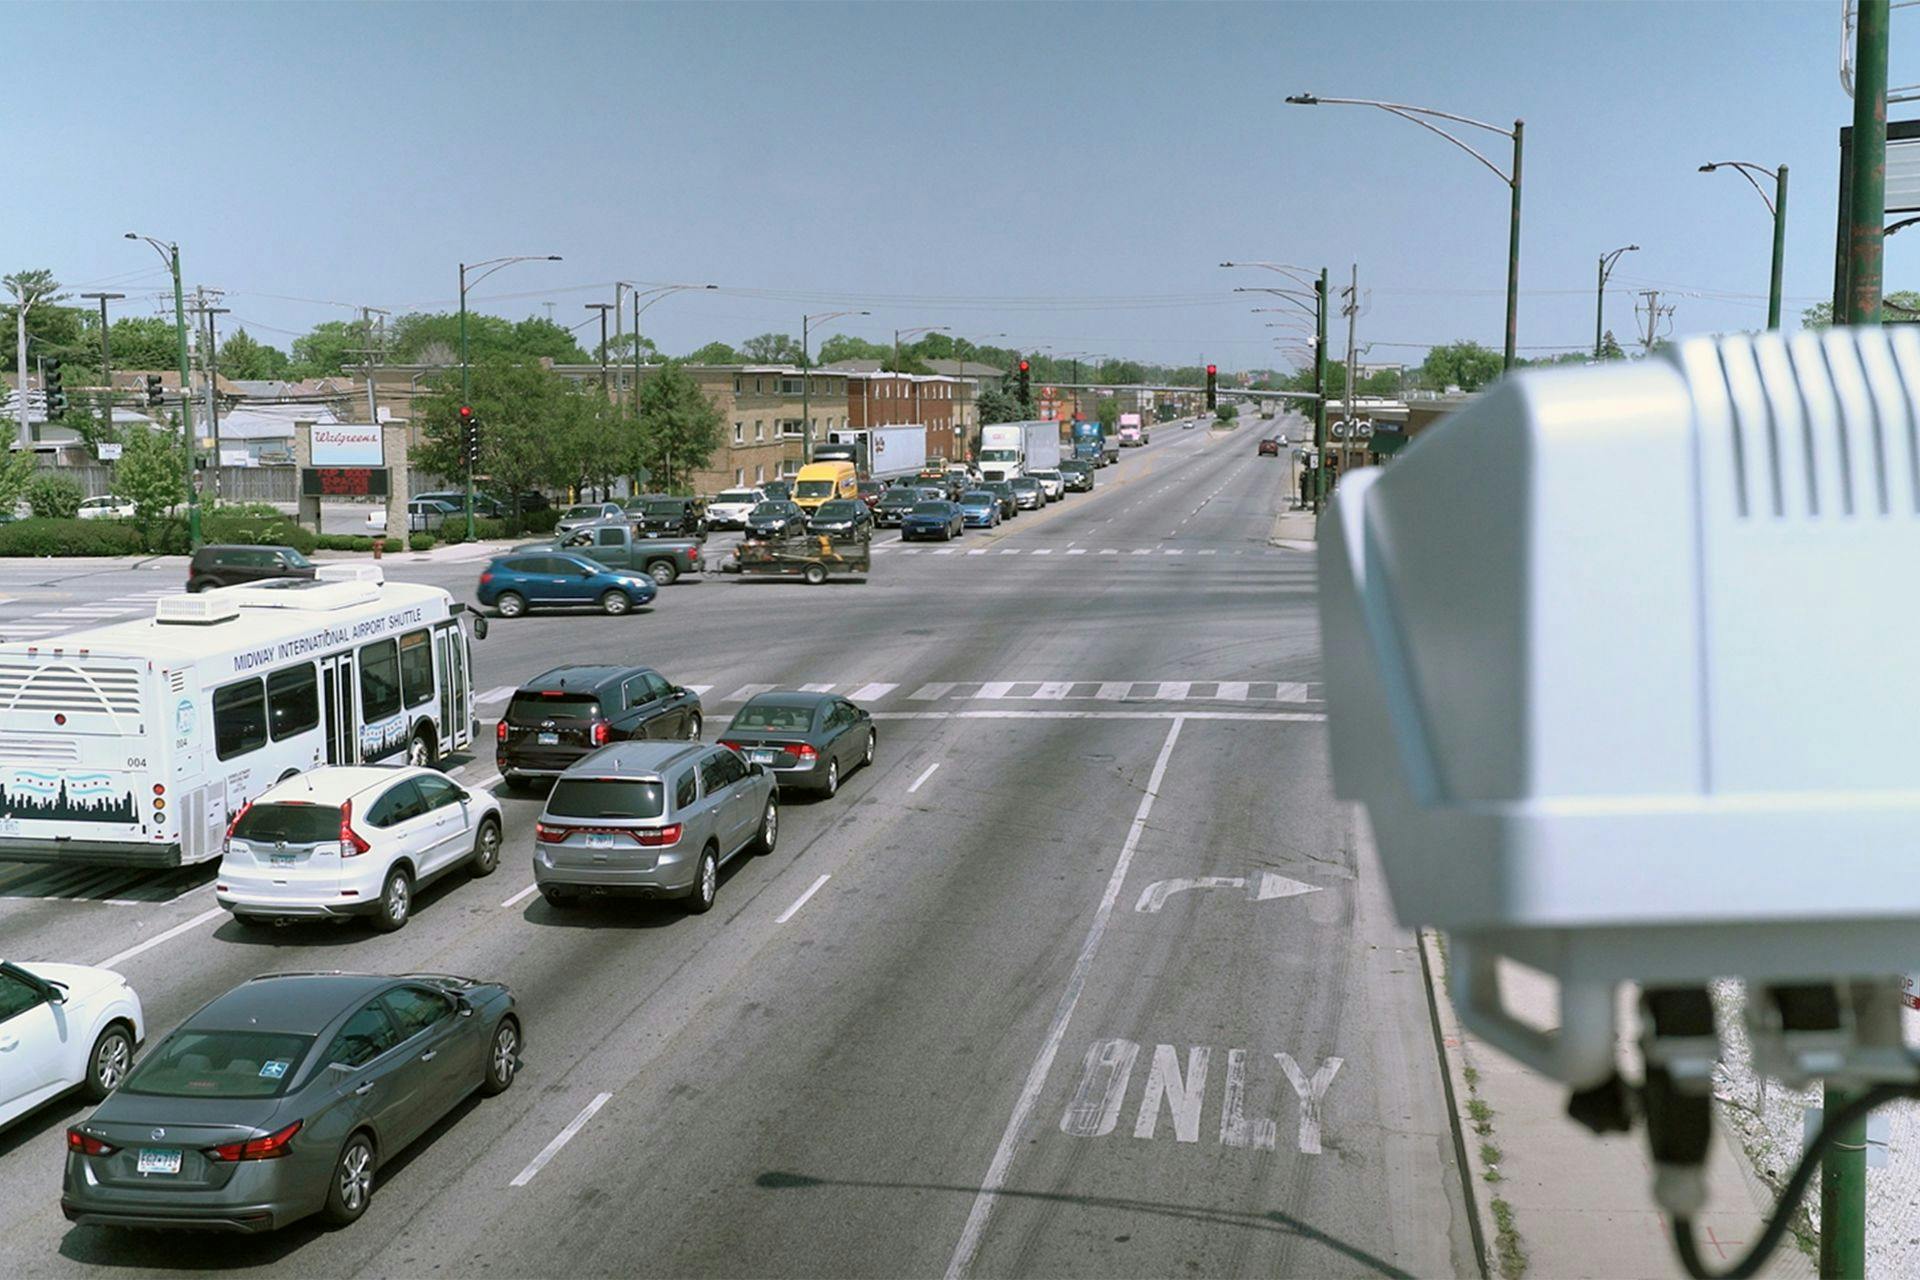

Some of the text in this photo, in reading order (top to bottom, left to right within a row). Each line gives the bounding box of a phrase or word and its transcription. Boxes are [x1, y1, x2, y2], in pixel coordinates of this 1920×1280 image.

[314, 431, 377, 446] Walgreens
[233, 608, 422, 671] MIDWAY INTERNATIONAL AIRPORT SHUTTLE
[175, 738, 188, 749] 004
[127, 757, 147, 769] 004
[1059, 1038, 1345, 1155] ONLY
